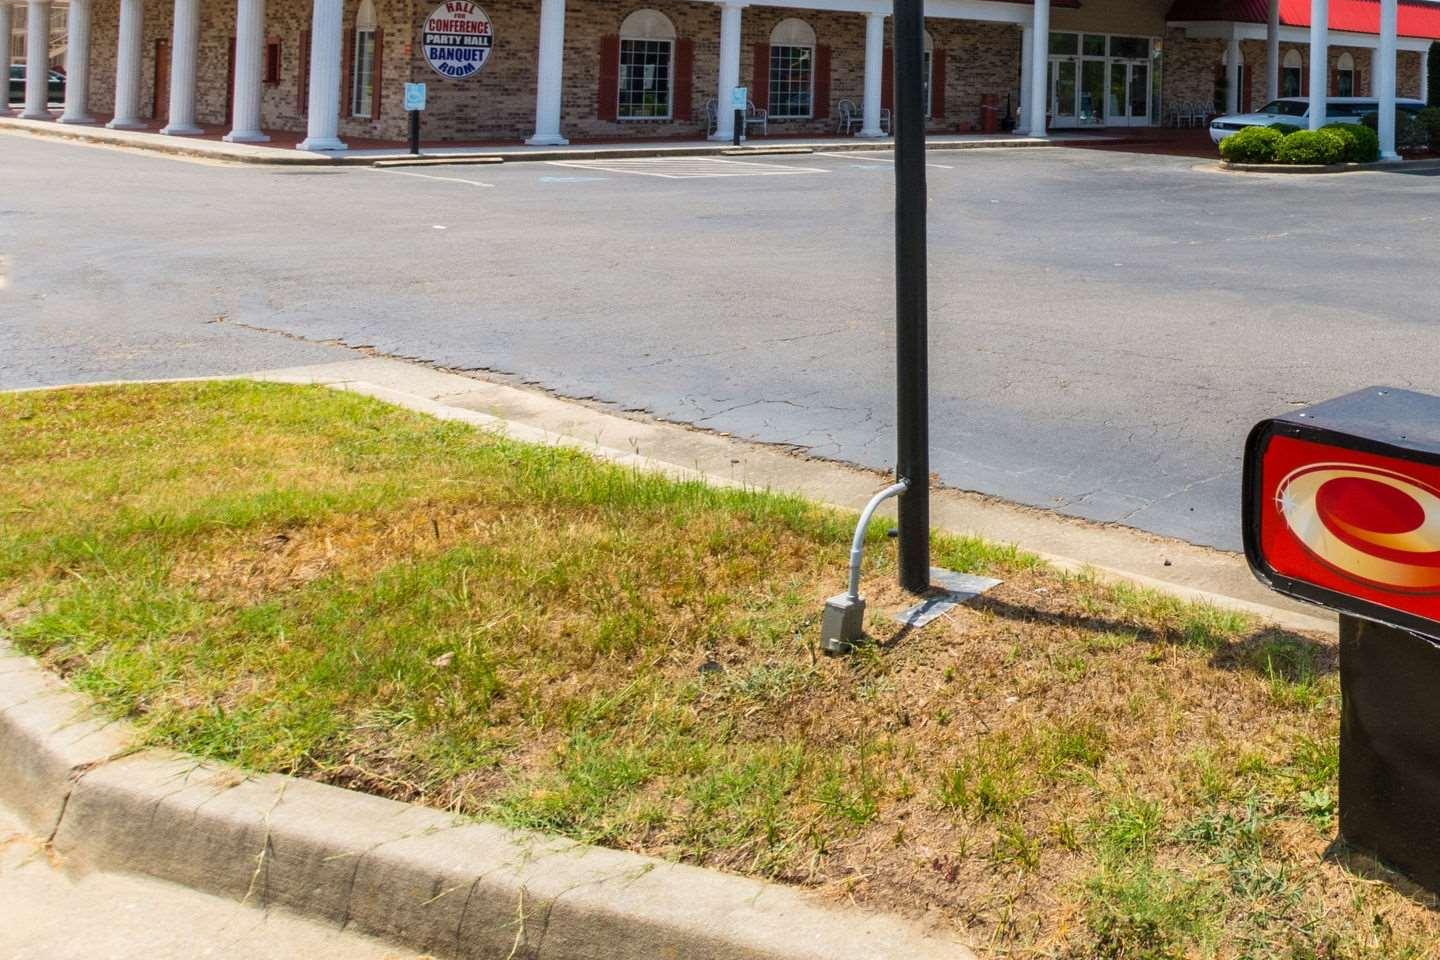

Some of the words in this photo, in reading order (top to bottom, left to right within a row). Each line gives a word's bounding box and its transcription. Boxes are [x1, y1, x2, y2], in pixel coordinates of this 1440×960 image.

[446, 2, 475, 14] HALL
[429, 19, 488, 33] CONFERENCE
[426, 35, 461, 44] PARTY
[464, 37, 488, 45] HALL
[430, 47, 485, 62] BANQUET
[439, 62, 475, 75] ROOM
